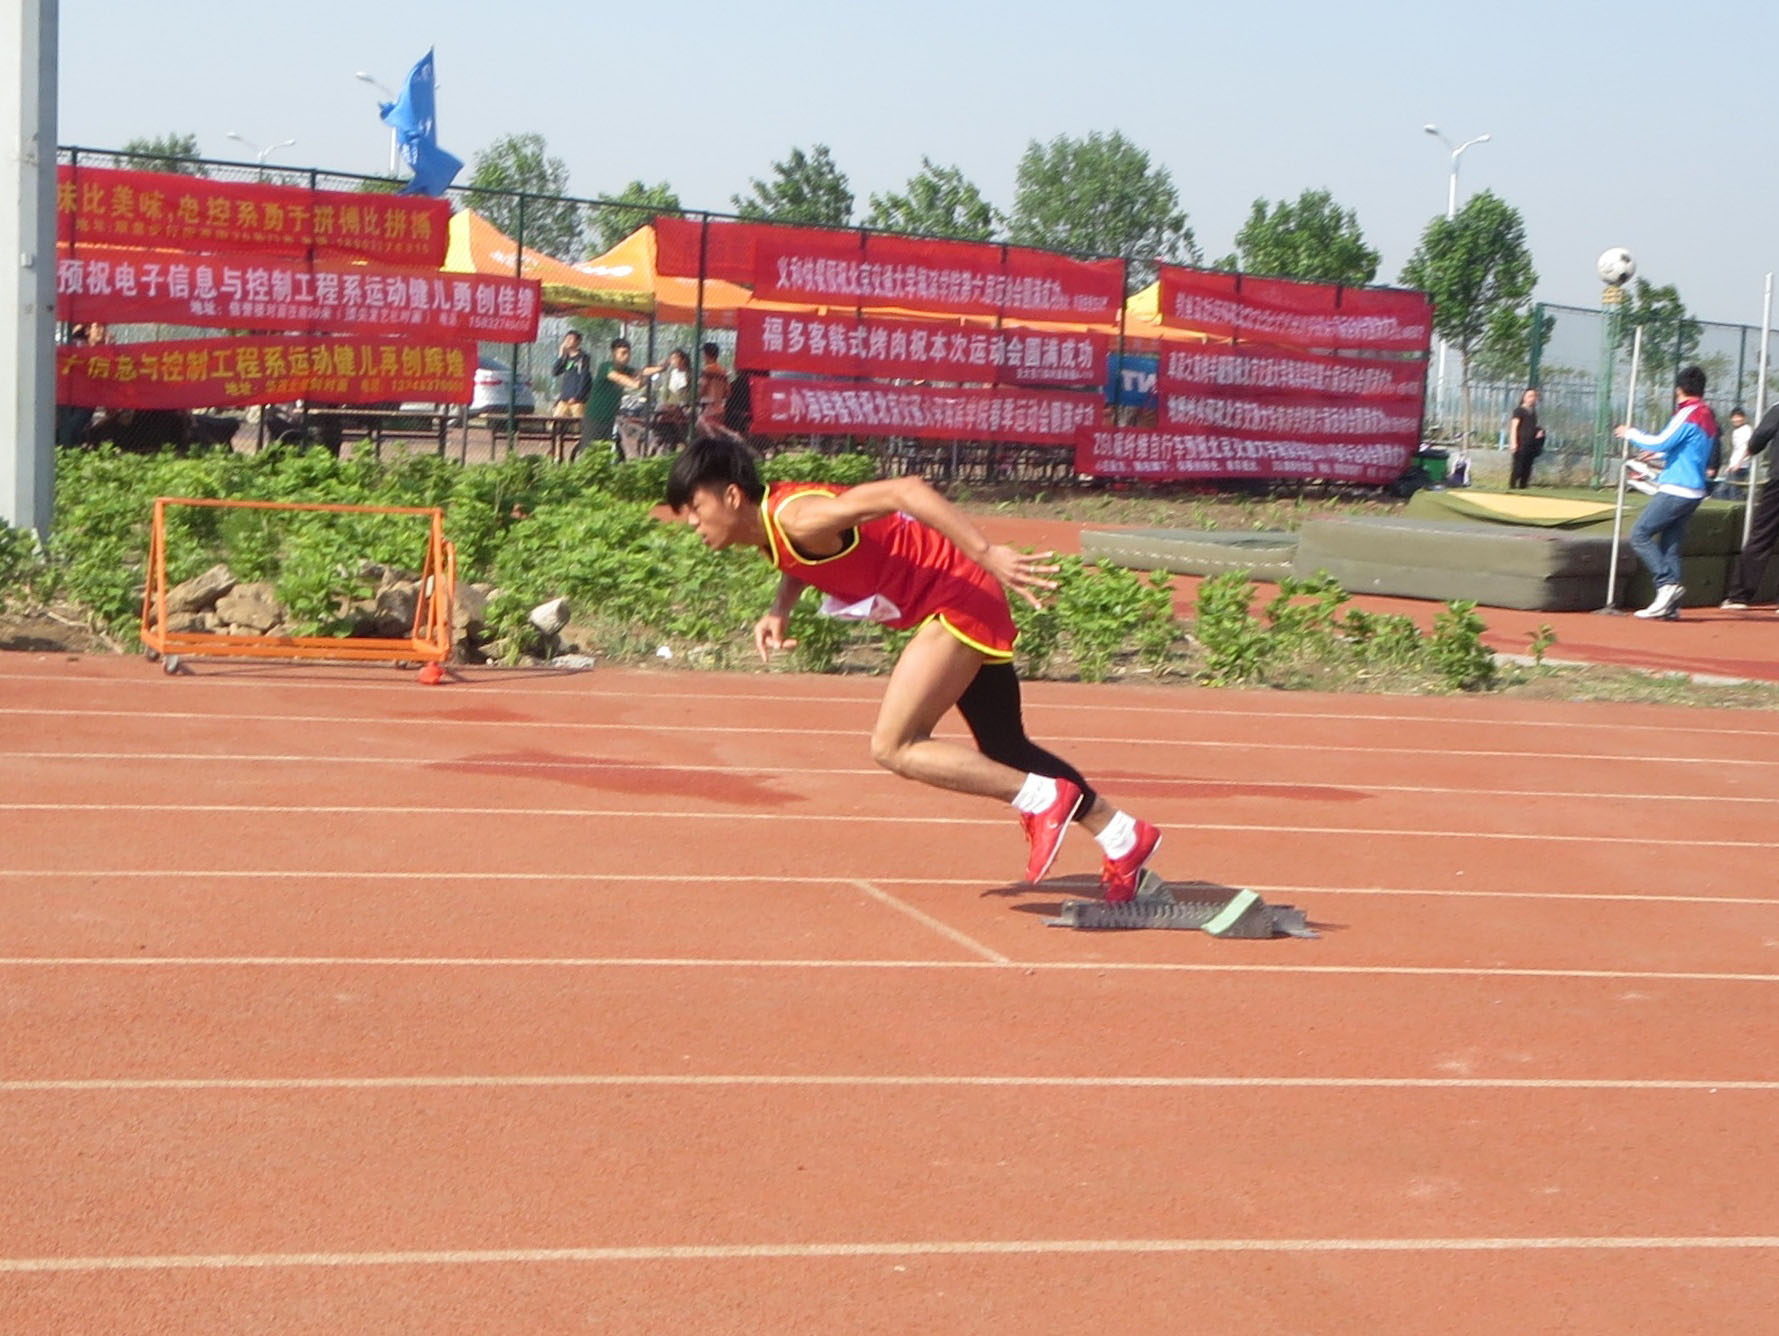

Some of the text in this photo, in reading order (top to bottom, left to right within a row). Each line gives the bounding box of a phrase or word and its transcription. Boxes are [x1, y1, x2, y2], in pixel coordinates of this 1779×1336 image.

[58, 260, 534, 316] 预祝电子信息与控制工程系运动健儿勇创佳绩
[763, 317, 1093, 367] 福多客韩式烤肉祝本次运动会圆满成功
